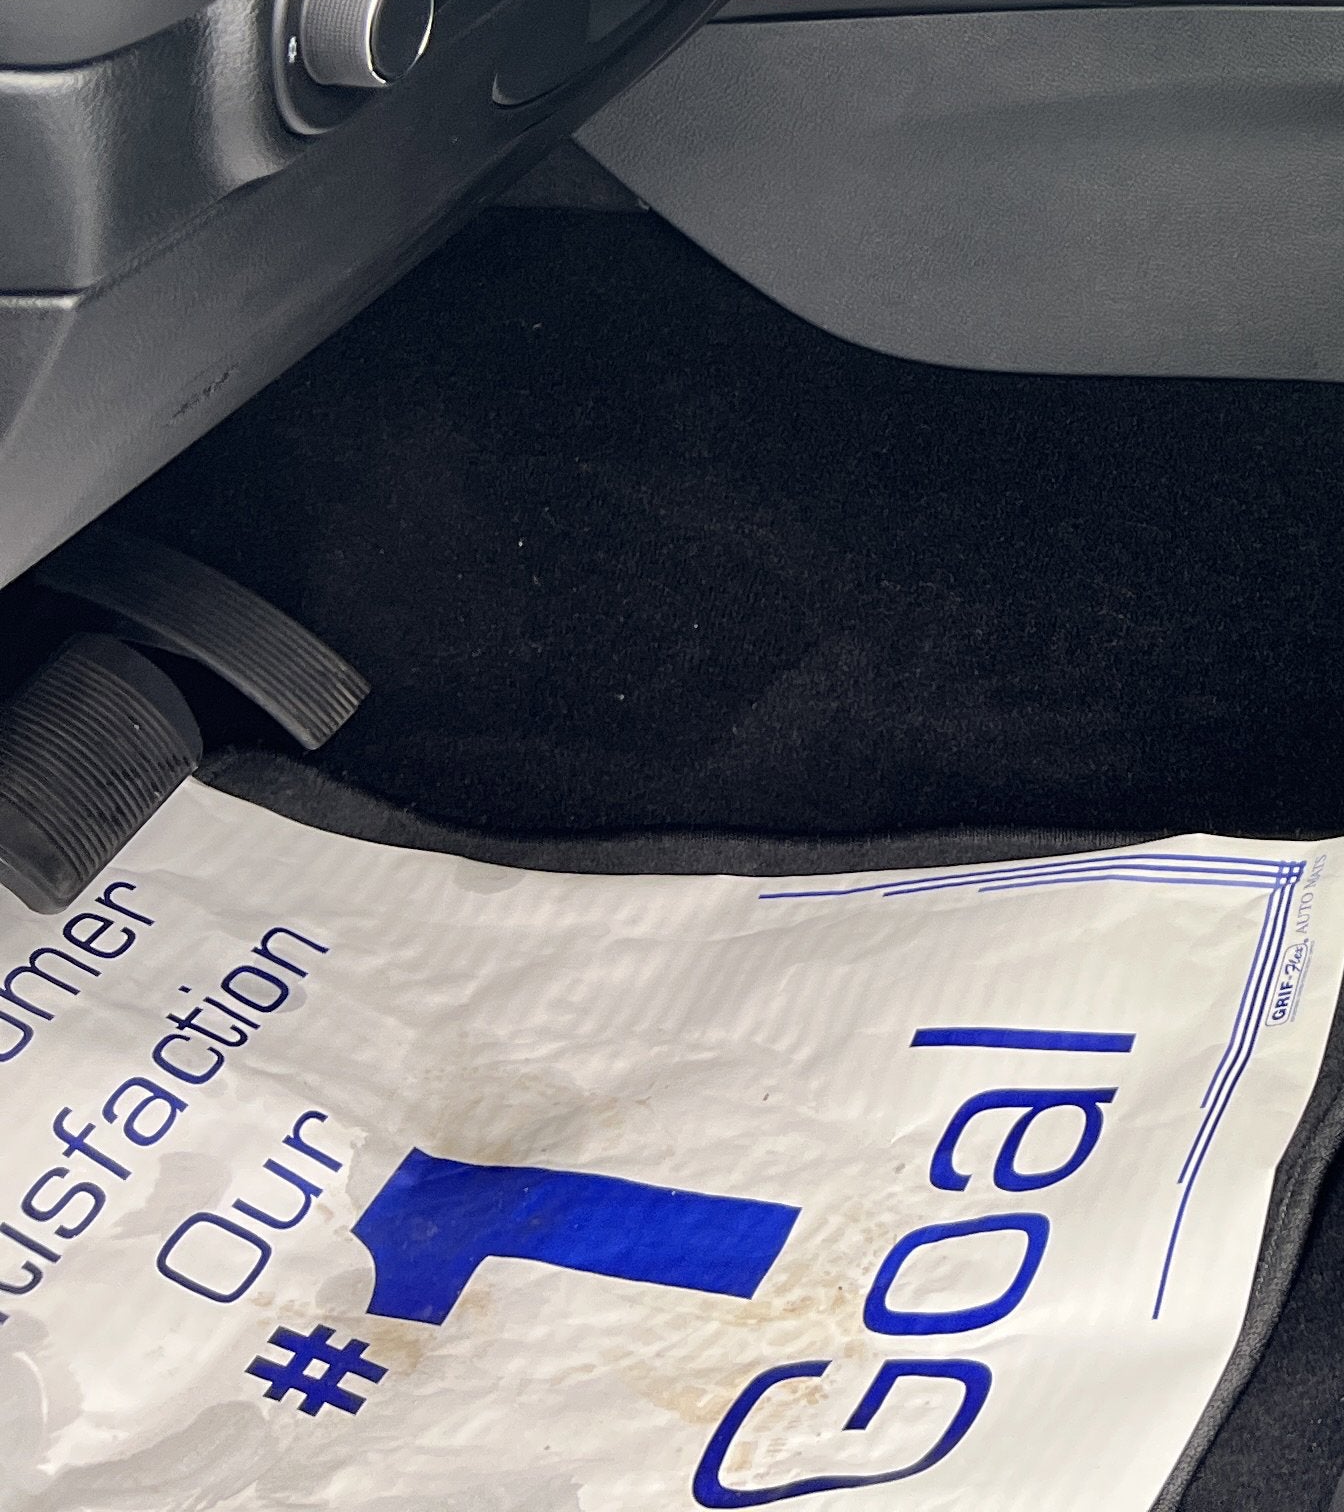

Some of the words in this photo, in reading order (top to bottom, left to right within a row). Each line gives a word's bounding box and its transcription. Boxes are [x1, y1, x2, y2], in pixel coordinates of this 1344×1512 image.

[1296, 891, 1314, 935] AUTO
[1303, 853, 1328, 891] MATS
[156, 1110, 343, 1304] Our
[692, 1027, 1137, 1509] Goal
